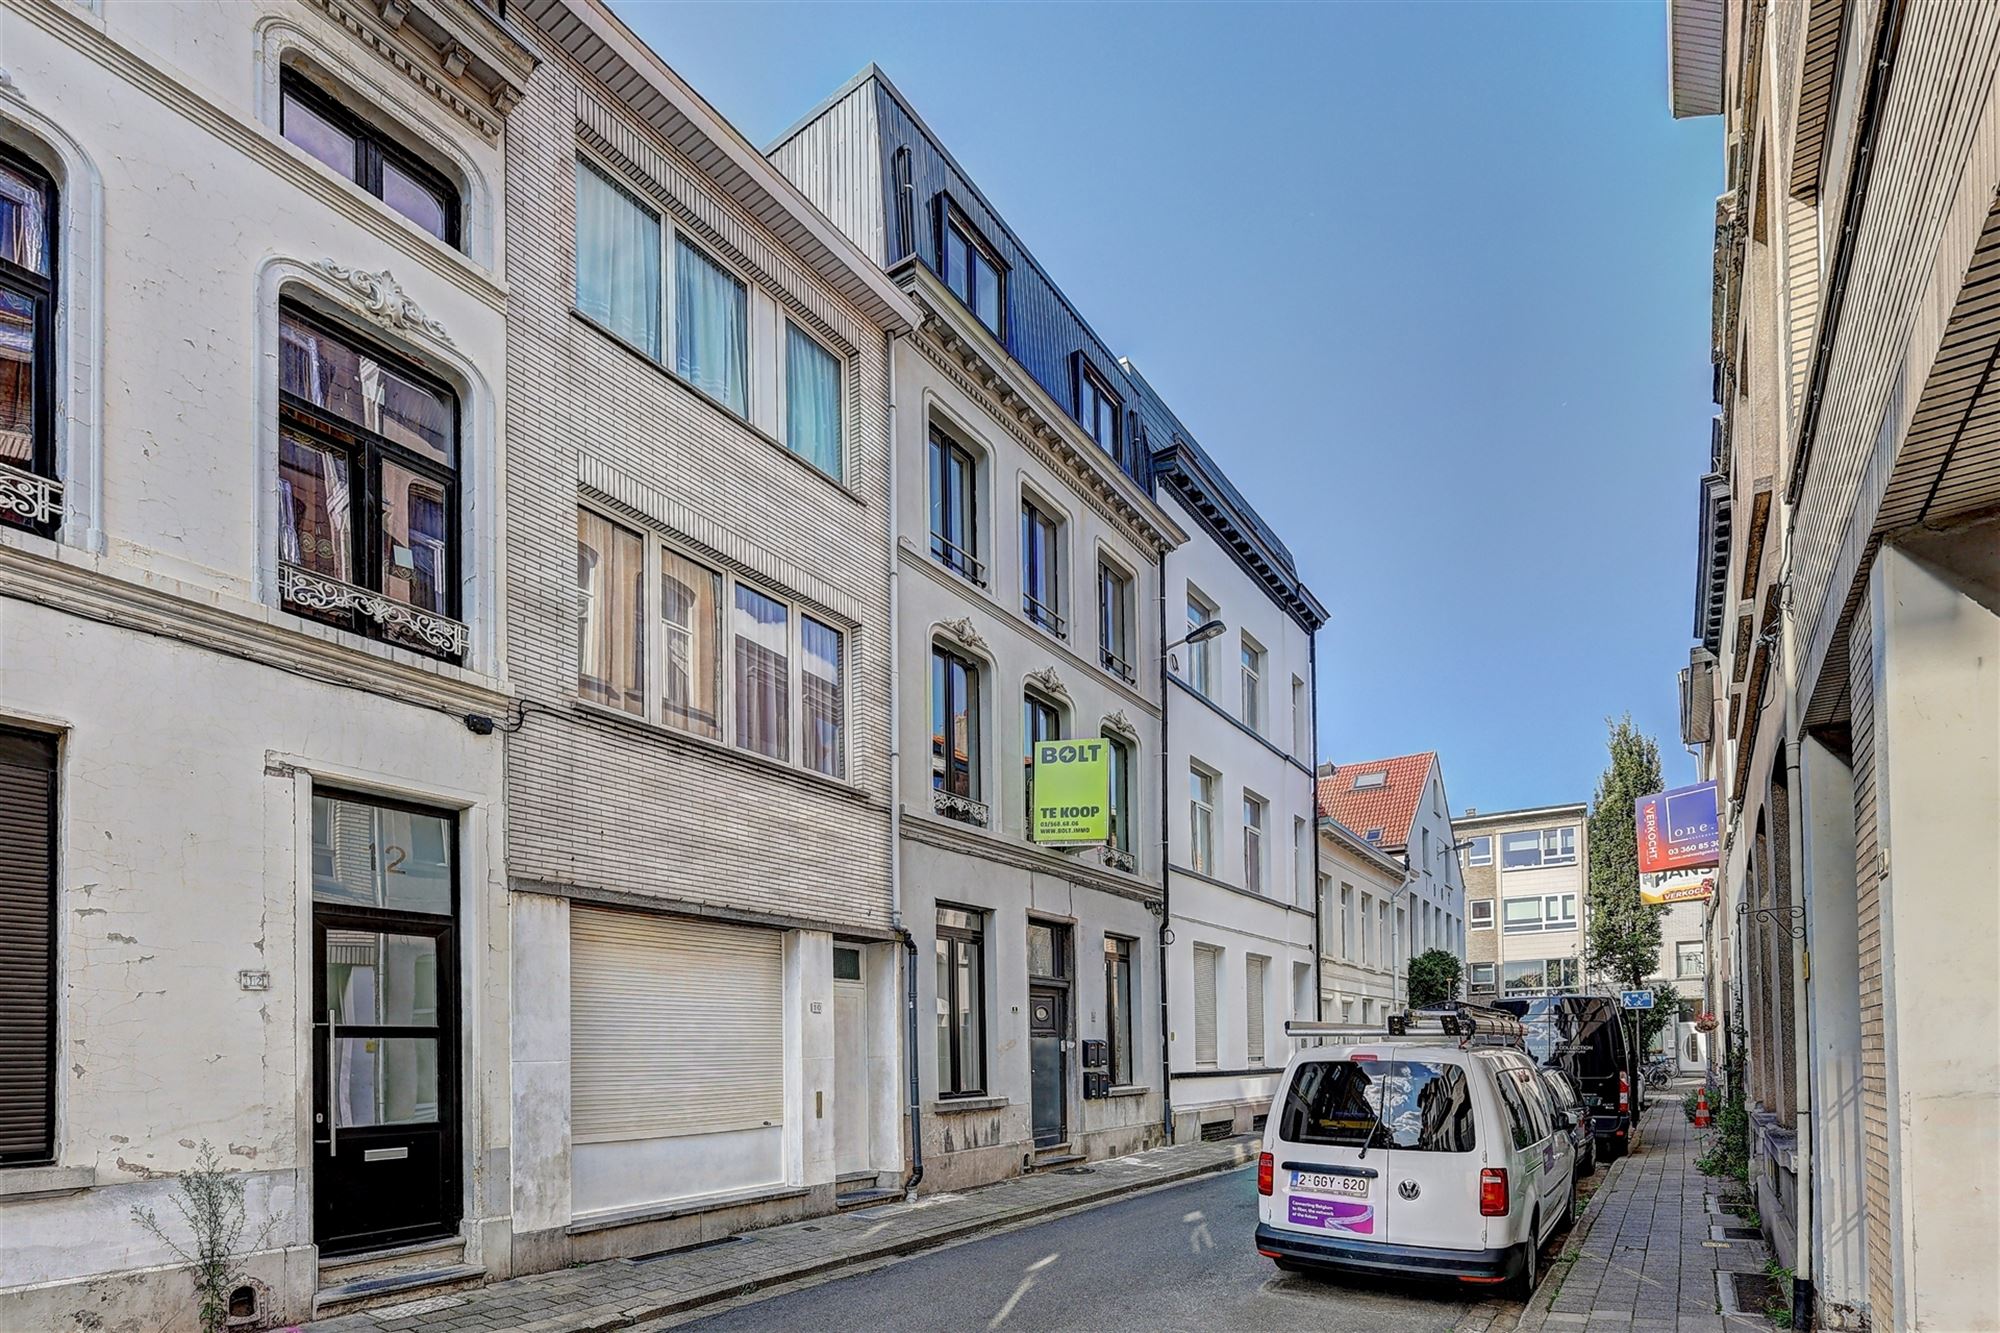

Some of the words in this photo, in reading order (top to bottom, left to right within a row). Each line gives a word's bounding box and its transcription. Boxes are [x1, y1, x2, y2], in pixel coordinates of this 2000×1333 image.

[1041, 745, 1102, 764] BOLT
[1040, 807, 1057, 818] TE
[1060, 806, 1100, 818] KOOP
[1646, 806, 1658, 859] VERKOCHT
[1668, 848, 1679, 856] 03
[1292, 1200, 1315, 1208] Connecting
